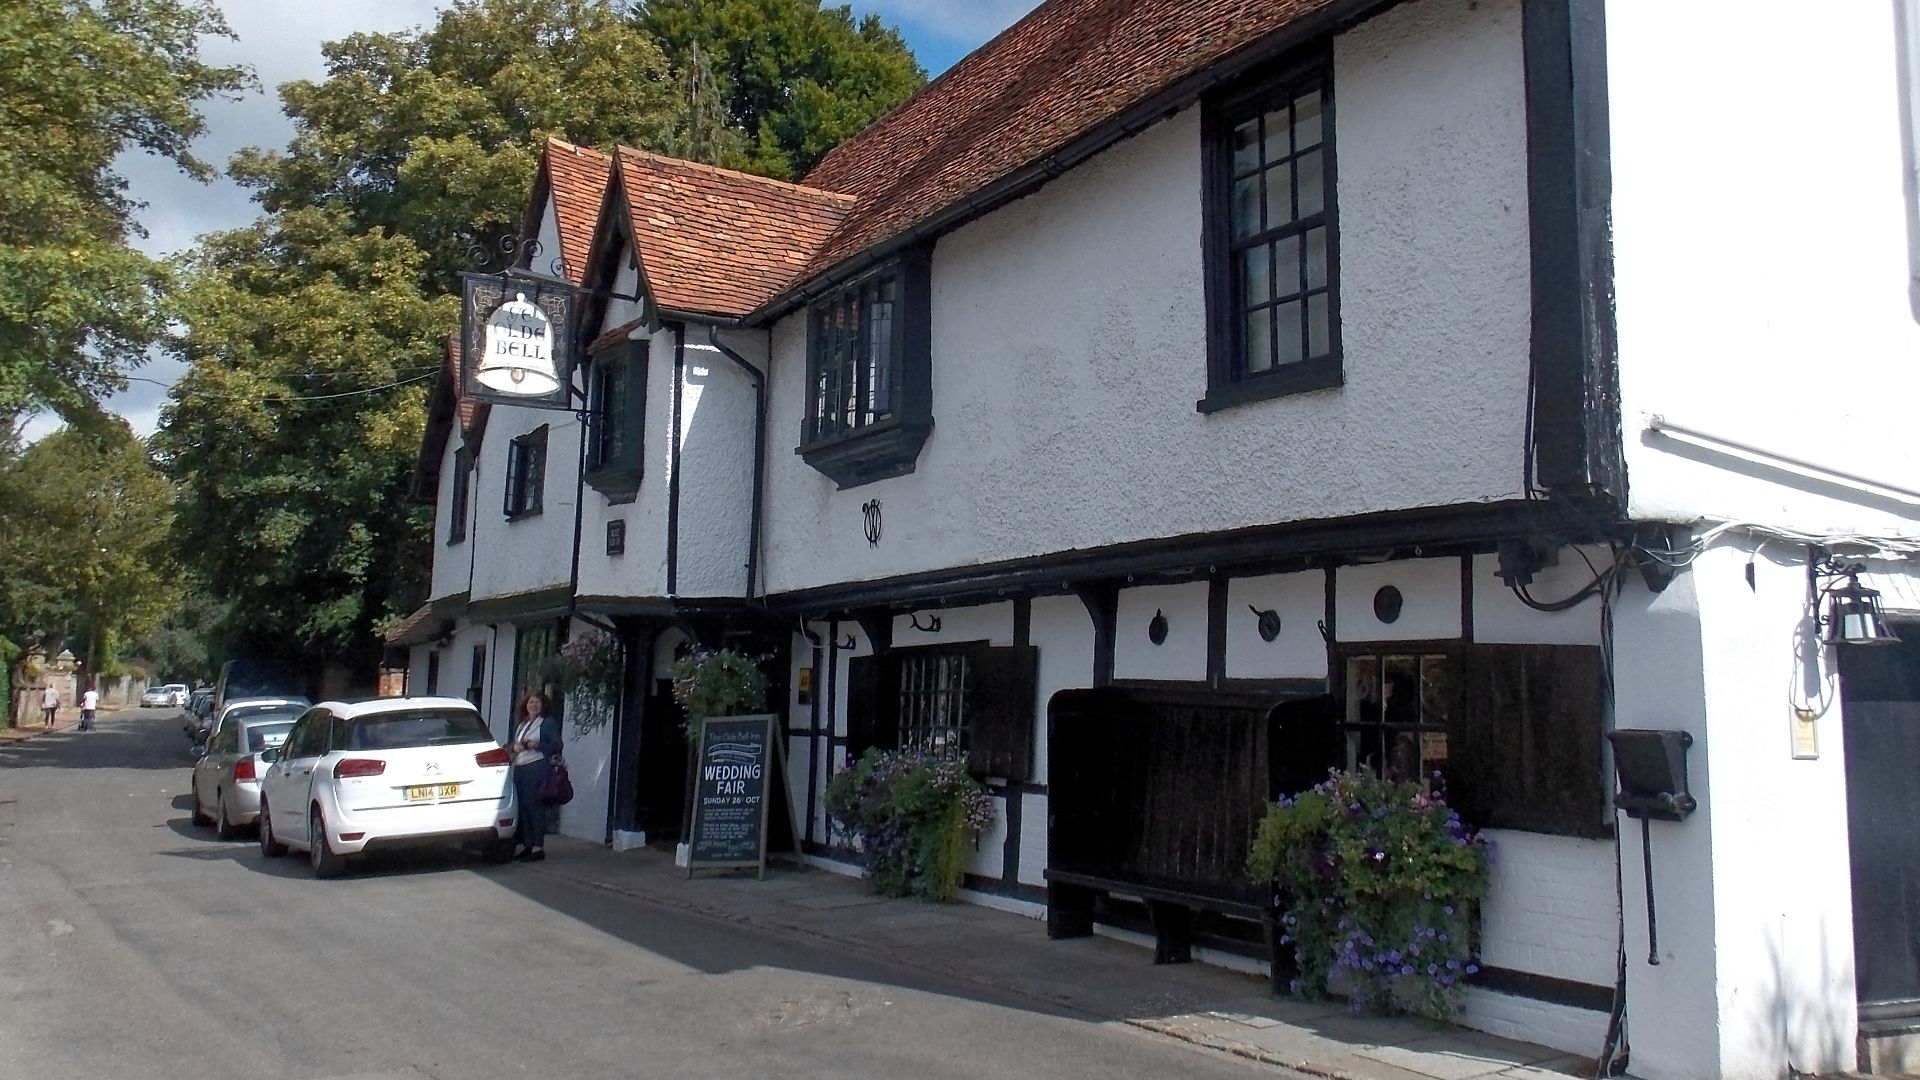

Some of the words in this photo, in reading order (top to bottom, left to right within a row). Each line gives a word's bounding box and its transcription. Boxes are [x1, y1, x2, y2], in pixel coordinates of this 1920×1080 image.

[494, 322, 546, 341] OLDE
[496, 340, 546, 360] BELL
[704, 764, 761, 781] WEDDING
[411, 788, 435, 799] LN14
[717, 780, 745, 795] FAIR
[703, 797, 731, 805] SUNDAY
[746, 796, 761, 804] OCT
